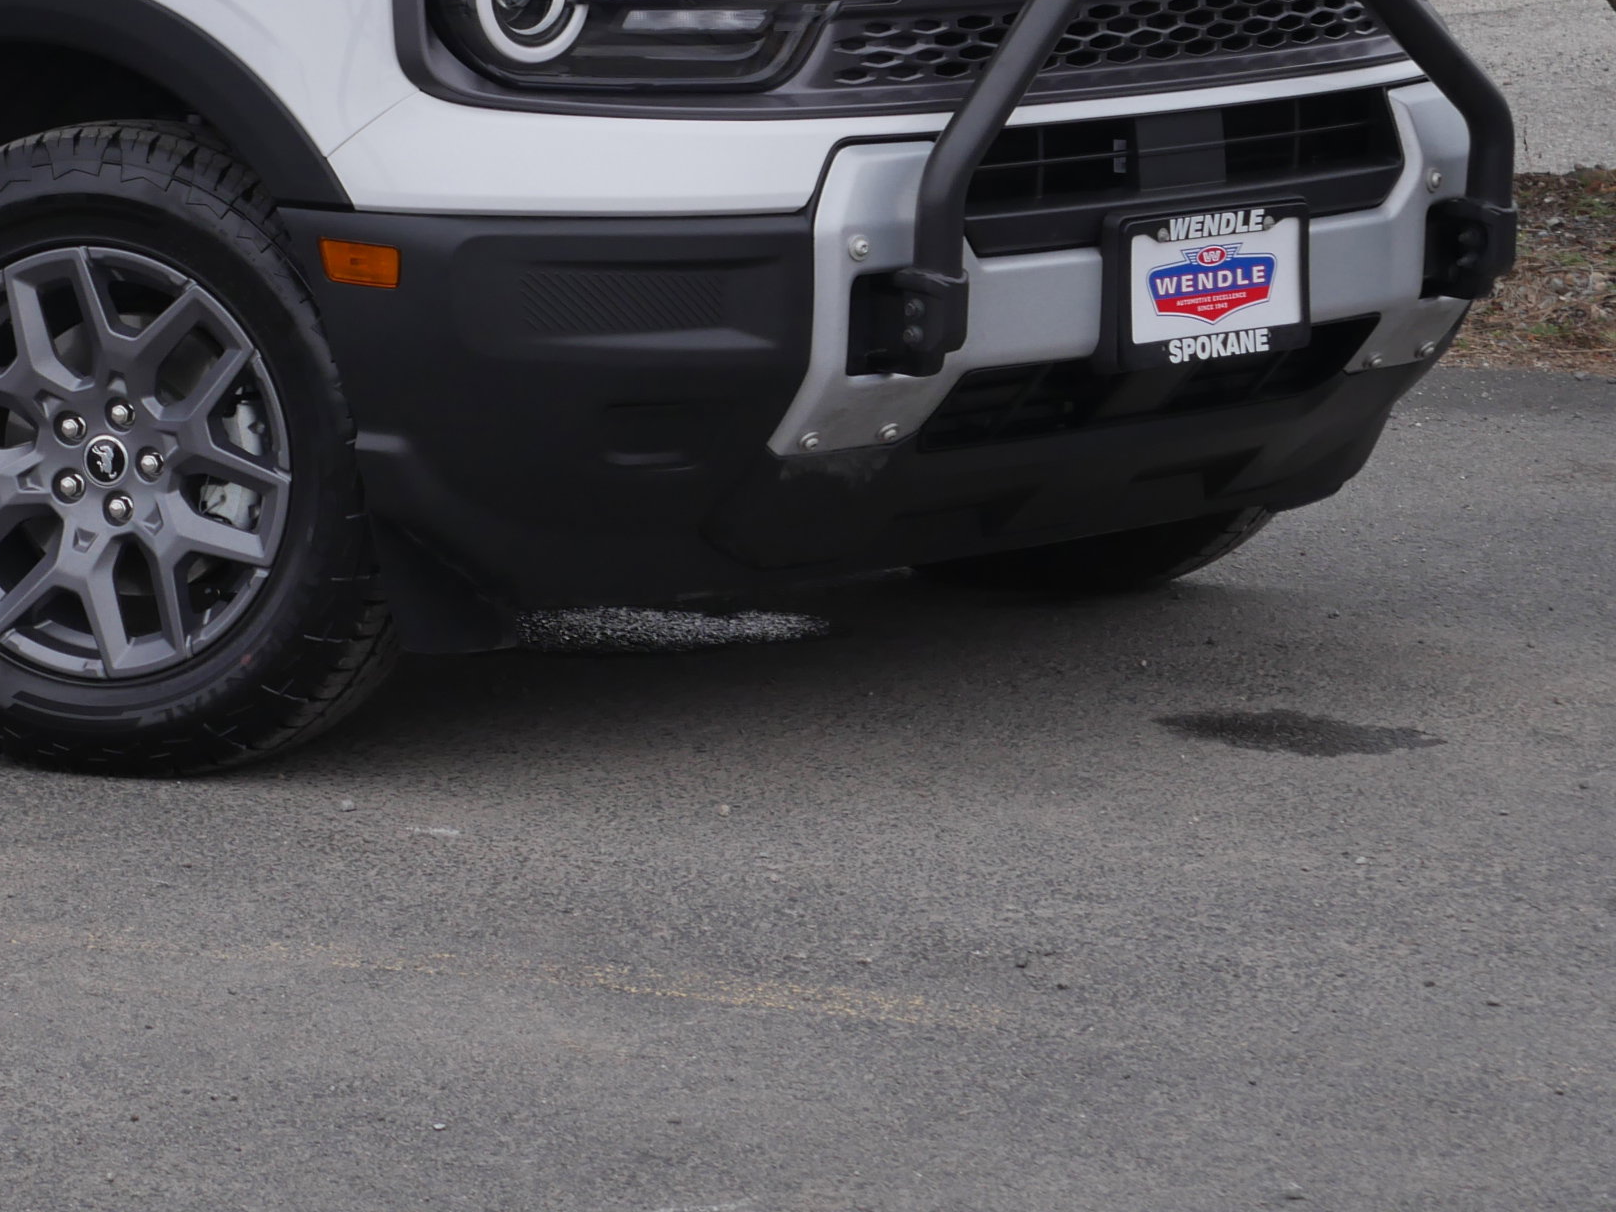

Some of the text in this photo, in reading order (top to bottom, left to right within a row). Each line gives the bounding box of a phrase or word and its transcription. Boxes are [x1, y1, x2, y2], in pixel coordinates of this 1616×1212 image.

[1169, 209, 1265, 241] WENDLE
[1156, 266, 1265, 295] WENDLE
[1176, 291, 1247, 306] AUTOMOTIVE EXCELLENCE
[1197, 304, 1214, 312] SINCE
[1168, 328, 1270, 364] SPOKANE
